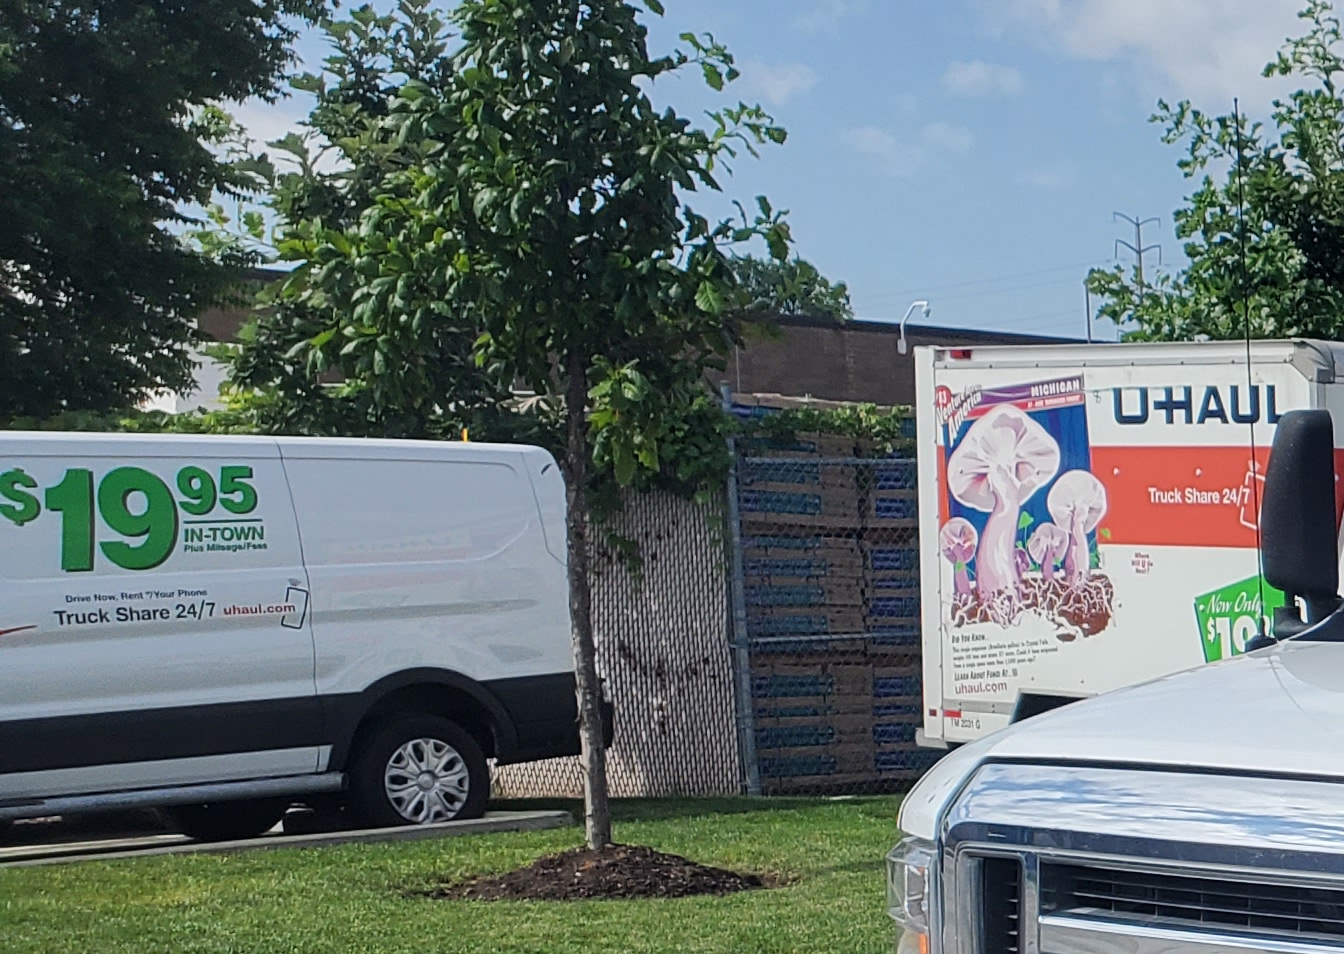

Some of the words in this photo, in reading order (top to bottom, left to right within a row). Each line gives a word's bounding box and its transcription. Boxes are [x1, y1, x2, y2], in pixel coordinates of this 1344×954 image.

[1031, 379, 1080, 397] MICHIGAN
[1112, 384, 1283, 425] U-HAUL
[1148, 487, 1182, 504] Truck
[1184, 487, 1220, 505] Share
[1222, 485, 1250, 507] 24/7
[184, 525, 265, 543] IN-TOWN
[184, 543, 204, 553] Plus
[207, 542, 268, 553] Mileage/Fees
[65, 594, 91, 604] Drive
[121, 591, 143, 601] Rent
[177, 588, 208, 597] Phone
[1207, 594, 1233, 614] Now
[53, 608, 110, 626] Truck
[116, 605, 170, 623] Share
[175, 600, 216, 621] 24/7
[223, 602, 296, 617] uhaul.com
[955, 682, 1008, 695] uhaul.com
